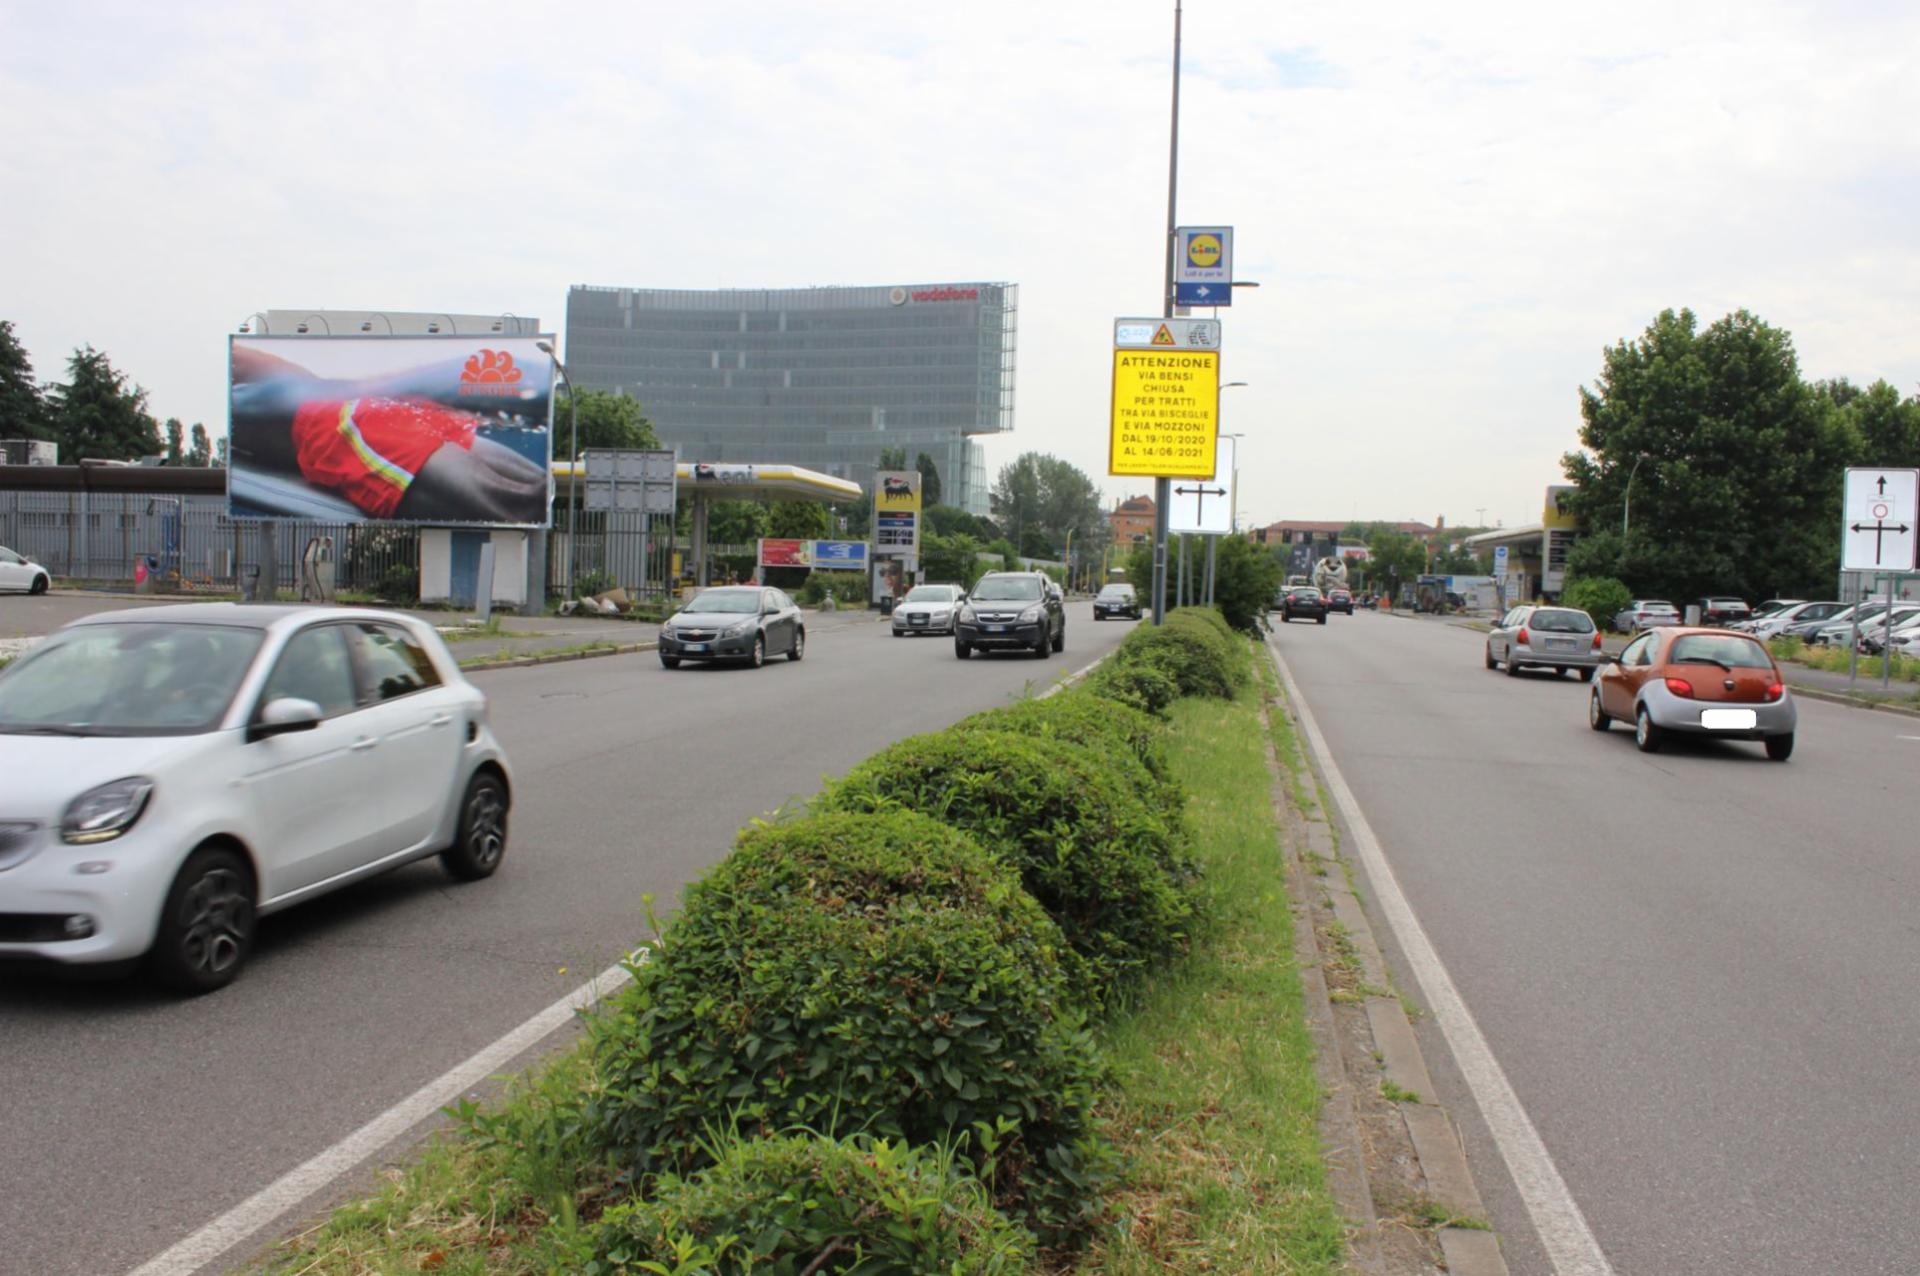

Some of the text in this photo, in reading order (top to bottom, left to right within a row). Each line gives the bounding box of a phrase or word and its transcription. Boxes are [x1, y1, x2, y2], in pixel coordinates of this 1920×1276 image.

[911, 286, 977, 302] vodafone
[1121, 357, 1212, 368] ATTENZIONE
[1138, 371, 1193, 381] VIA BENSI
[1143, 384, 1185, 393] CHIUSA
[1134, 397, 1196, 406] PER TRATTI
[1120, 409, 1209, 419] TRA VIA BISCEGLIE
[1123, 421, 1205, 431] E VIA MOZZONI
[1122, 434, 1206, 445] DAL 19/10/2020
[1124, 447, 1203, 457] AL 14/06/2021
